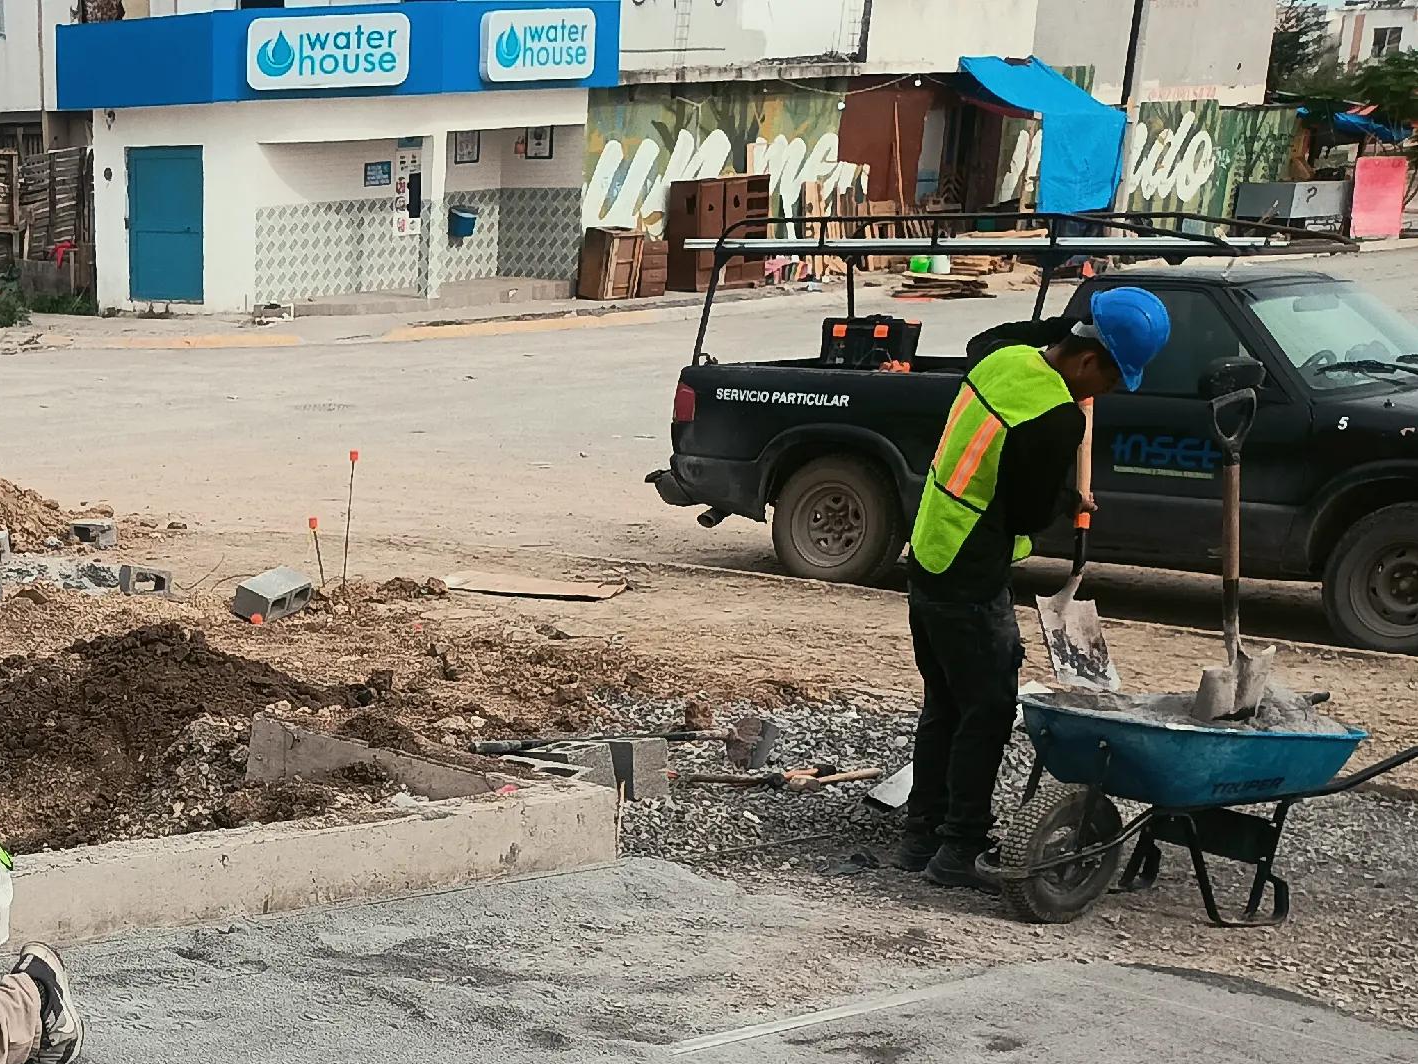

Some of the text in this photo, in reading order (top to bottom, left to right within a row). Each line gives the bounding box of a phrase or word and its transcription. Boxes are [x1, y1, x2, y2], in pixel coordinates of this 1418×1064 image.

[306, 25, 397, 51] water
[529, 19, 587, 43] water
[299, 34, 397, 76] house
[523, 27, 587, 67] house
[716, 388, 850, 407] SERVICIO PARTICULAR
[1337, 416, 1350, 431] 5
